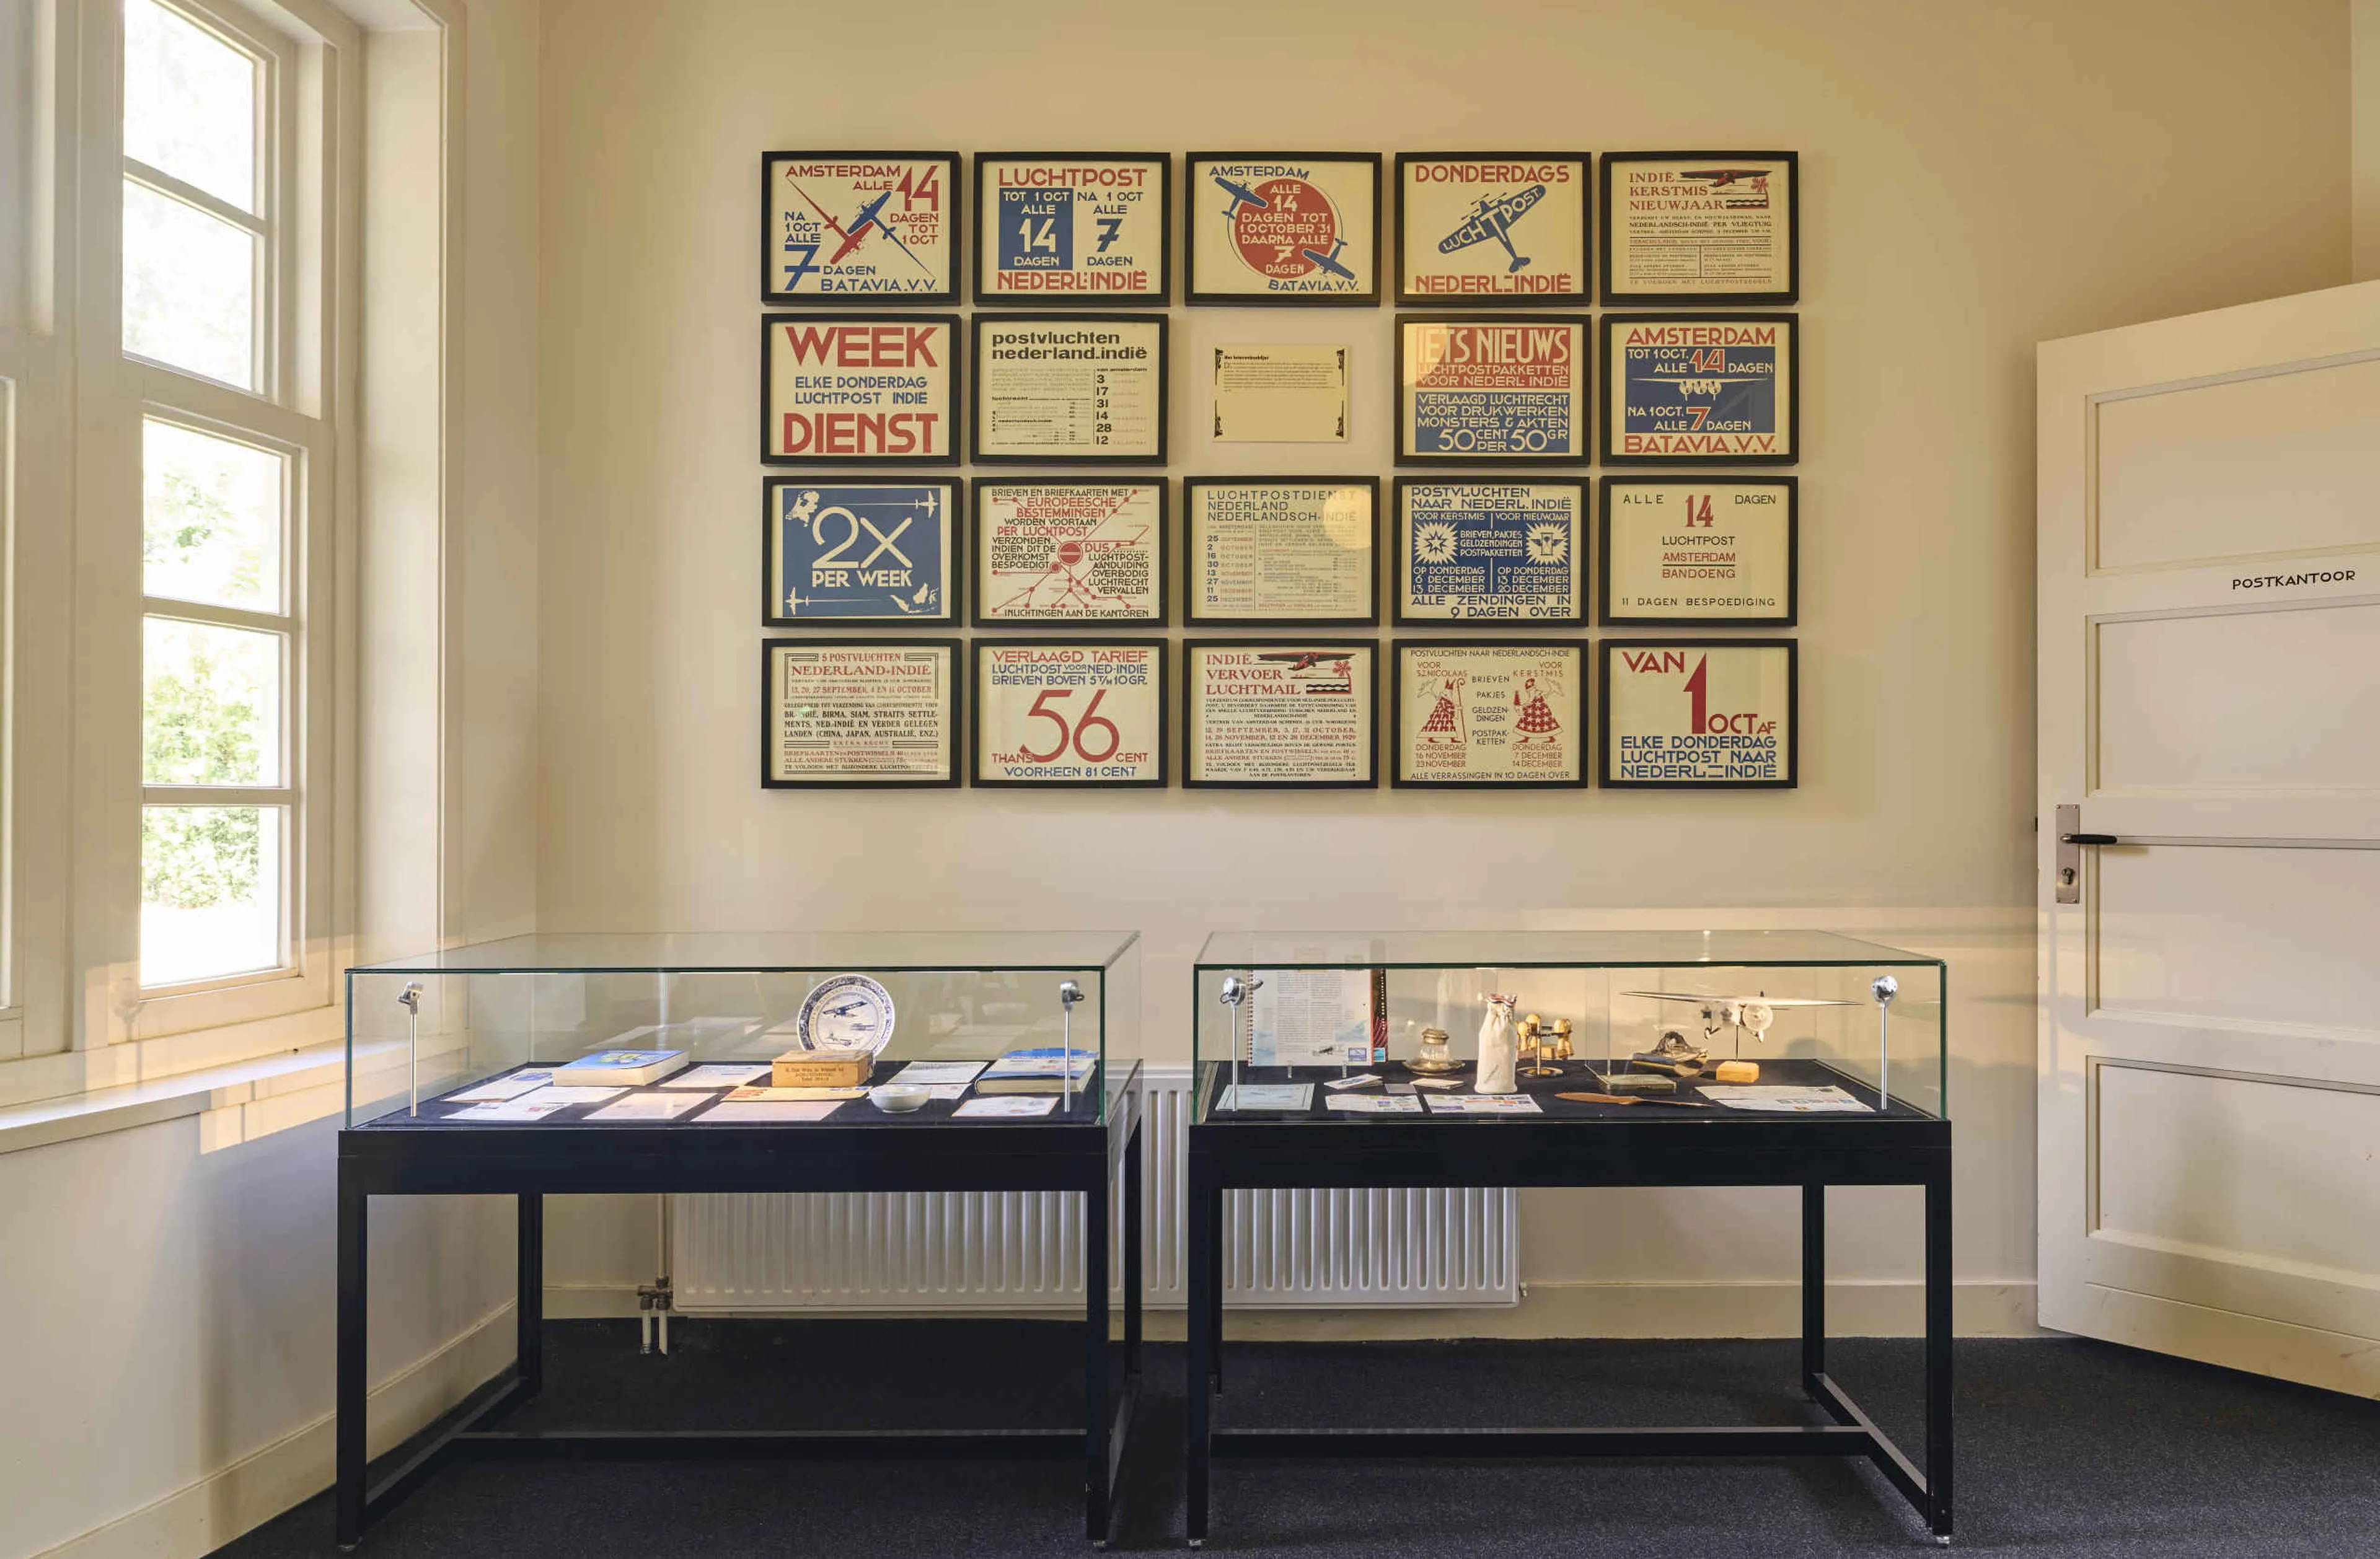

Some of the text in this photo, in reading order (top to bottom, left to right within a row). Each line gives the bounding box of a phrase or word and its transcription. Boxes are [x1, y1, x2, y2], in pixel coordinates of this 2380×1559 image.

[785, 165, 901, 177] AMSTERDAM
[1209, 166, 1310, 180] AMSTERDAM
[1416, 165, 1570, 182] DONDERDAGS
[999, 169, 1147, 187] LUCHTPOST
[853, 165, 938, 211] ALLE 14
[1270, 185, 1301, 194] ALLE
[1629, 187, 1708, 196] KERSTMIS
[1003, 192, 1070, 201] TOT OCT
[1077, 192, 1143, 201] NA OCT
[1274, 195, 1298, 212] 14
[1629, 200, 1723, 210] NIEUWJAAR
[1021, 205, 1056, 214] ALLE
[1093, 204, 1127, 214] ALLE
[785, 211, 805, 221] NA
[890, 214, 938, 223] DAGEN
[1242, 213, 1328, 222] DAGEN TOT
[908, 224, 938, 233] TOT
[1248, 224, 1315, 233] OCTOBER
[785, 234, 821, 243] ALLE
[1019, 218, 1056, 253] 14
[1096, 218, 1123, 252] 7
[1242, 235, 1328, 244] DAARNA ALLE
[1274, 245, 1295, 263] 7
[1014, 257, 1059, 266] DAGEN
[1087, 257, 1132, 266] DAGEN
[784, 244, 876, 291] 7 DAGEN
[1266, 265, 1303, 274] DAGEN
[992, 332, 1120, 346] postvluchten
[1626, 327, 1775, 345] AMSTERDAM
[785, 327, 938, 367] WEEK
[1418, 329, 1568, 363] IETS NIEUWS
[1628, 349, 1650, 359] TOT
[1654, 349, 1773, 372] ALLE 14 DAGEN
[1417, 365, 1568, 375] LUCHTPOSTPAKKETTEN
[796, 377, 927, 388] ELKE DONDERDAG
[1096, 375, 1104, 384] 3
[1421, 376, 1459, 386] VOOR
[1096, 387, 1109, 395] 17
[796, 393, 881, 403] LUCHTPOST
[1417, 394, 1567, 405] VERLAAGD LUCHTRECHT
[1096, 399, 1109, 408] 31
[1096, 412, 1108, 420] 14
[1419, 406, 1568, 416] VOOR DRUKWERKEN
[1628, 407, 1647, 416] NA
[1418, 418, 1567, 428] MONSTERS AKTEN
[1654, 406, 1751, 431] ALLE 7 DAGEN
[783, 413, 938, 453] DIENST
[1096, 424, 1111, 433] 28
[1096, 436, 1109, 444] 12
[1438, 429, 1509, 450] 50 CENT
[1510, 429, 1567, 451] 50 GR
[1477, 441, 1507, 451] PER
[1412, 487, 1530, 497] POSTVLUCHTEN
[1027, 498, 1116, 507] EUROPEESCHE
[1208, 502, 1288, 511] NEDERLAND
[1412, 499, 1452, 509] NAAR
[1016, 509, 1106, 517] BESTEMMINGEN
[1623, 494, 1776, 527] ALLE 14 DAGEN
[998, 527, 1087, 536] PER LUCHTPOST
[812, 506, 912, 568] 2X
[1662, 536, 1735, 545] LUCHTPOST
[1662, 553, 1735, 561] AMSTERDAM
[812, 570, 912, 587] PER WEEK
[1662, 569, 1735, 578] BANDOENG
[2232, 570, 2356, 590] POSTKANTOOR
[1412, 595, 1571, 605] ALLE ZENDINGEN IN
[1686, 598, 1775, 606] BESPOEDIGING
[1005, 609, 1063, 617] INLICHTINGEN
[1451, 607, 1571, 617] 9 DAGEN OVER
[829, 654, 901, 662] POSTVLUCHTEN
[993, 651, 1148, 662] VERLAAGD TARIEF
[992, 664, 1062, 674] LUCHTPOST
[1206, 669, 1283, 680] VERVOER
[992, 675, 1085, 685] BRIEVEN BOVEN
[1205, 685, 1301, 695] LUCHTMAIL
[1623, 652, 1776, 734] VAN 1 OCT AF
[992, 689, 1148, 763] THANS 56 CENT
[1621, 736, 1776, 749] ELKE DONDERDAG
[1621, 750, 1776, 763] LUCHTPOST NAAR
[1004, 766, 1137, 776] VOORHEEN 81 CENT
